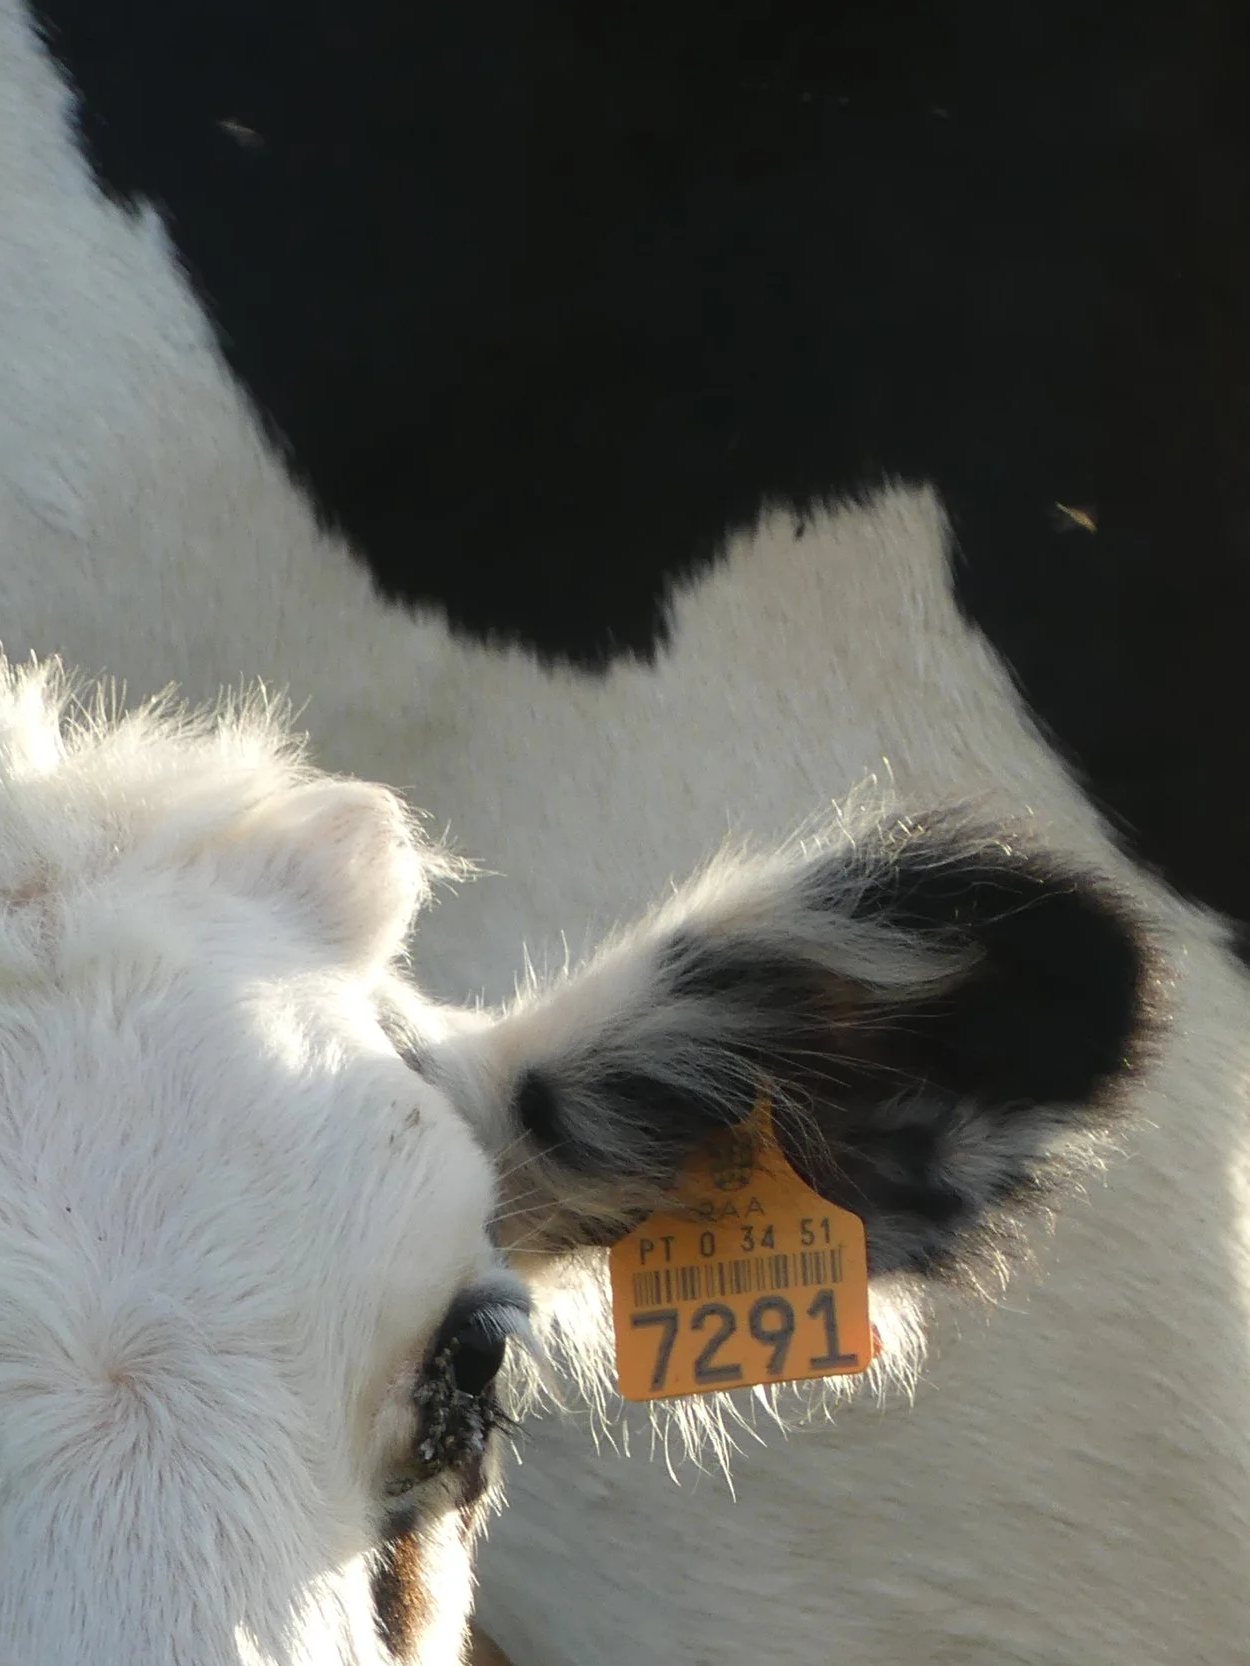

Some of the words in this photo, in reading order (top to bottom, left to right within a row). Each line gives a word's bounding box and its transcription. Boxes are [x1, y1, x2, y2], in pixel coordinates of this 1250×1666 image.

[638, 1235, 675, 1265] PT
[699, 1231, 715, 1258] 0
[740, 1223, 776, 1252] 34
[800, 1217, 831, 1246] 51
[631, 1289, 858, 1391] 7291
